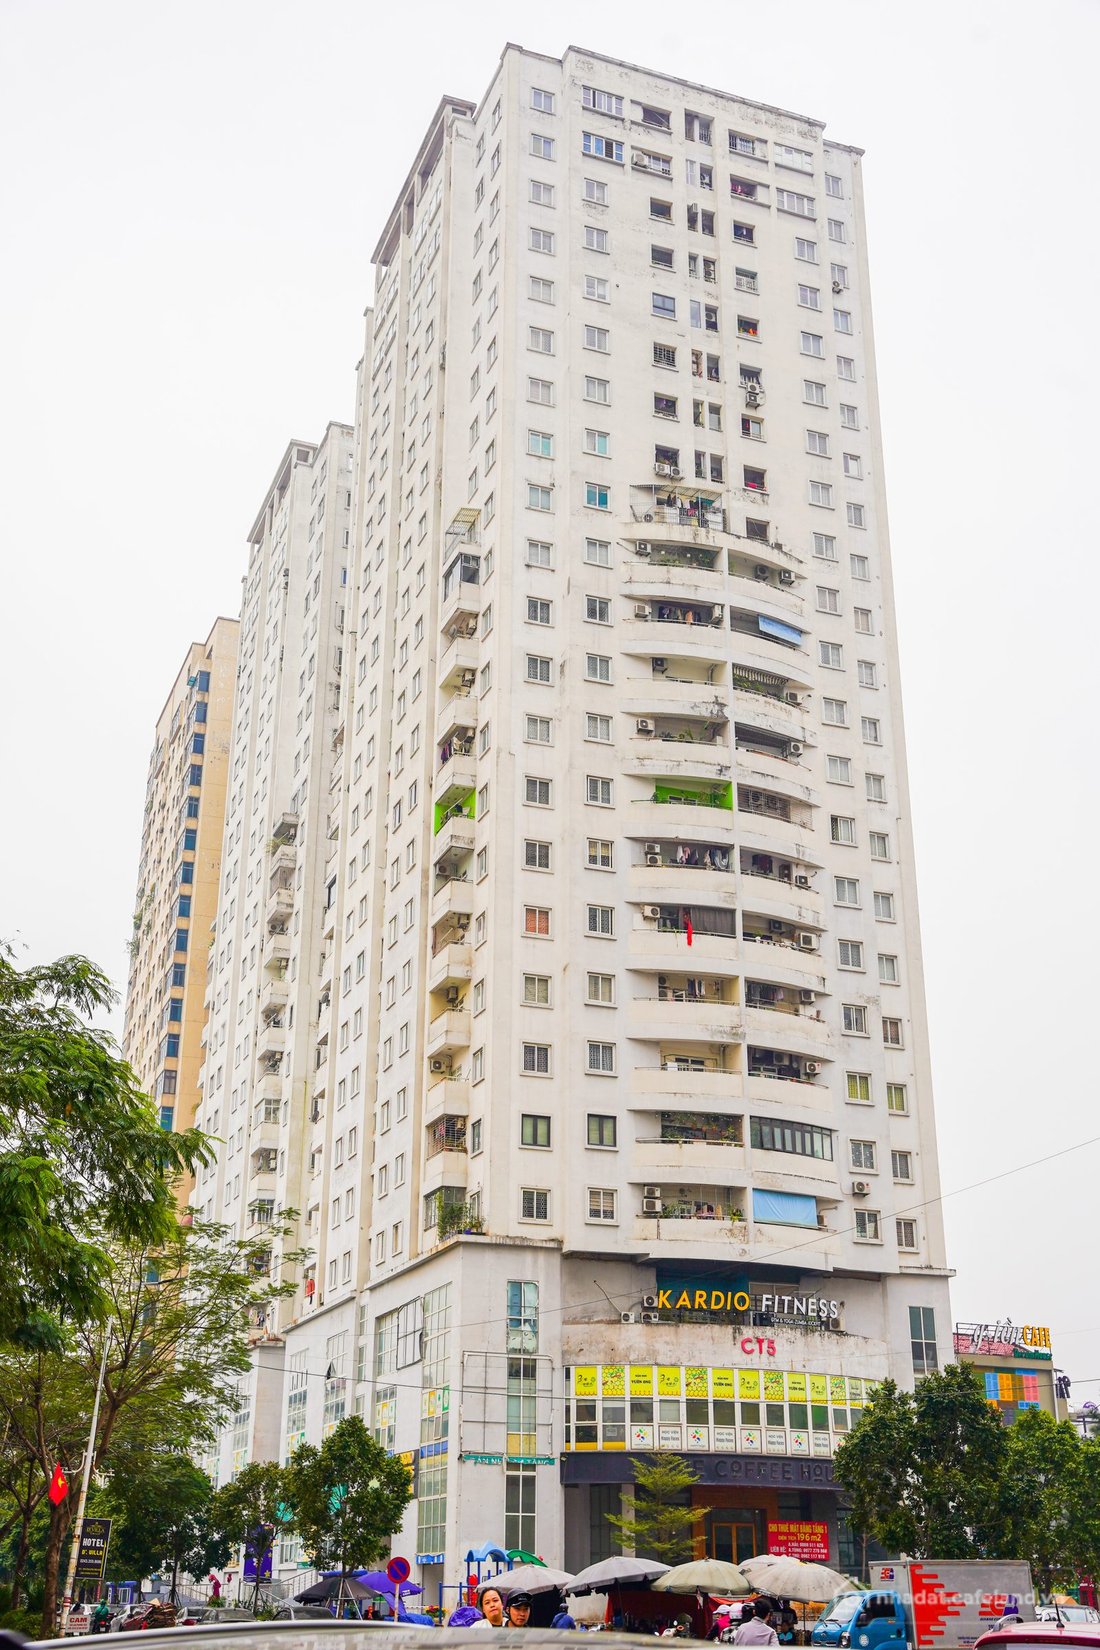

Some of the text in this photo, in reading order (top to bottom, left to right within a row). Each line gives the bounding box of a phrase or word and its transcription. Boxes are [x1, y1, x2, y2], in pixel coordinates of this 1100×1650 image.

[658, 1289, 839, 1319] KARDIO FITNESS
[741, 1337, 777, 1357] CT5
[1022, 1325, 1052, 1349] CAFE
[715, 1459, 793, 1481] COFFEE
[769, 1523, 778, 1533] CHO
[797, 1533, 811, 1541] 196
[811, 1533, 822, 1542] m2
[83, 1538, 105, 1547] HOTEL
